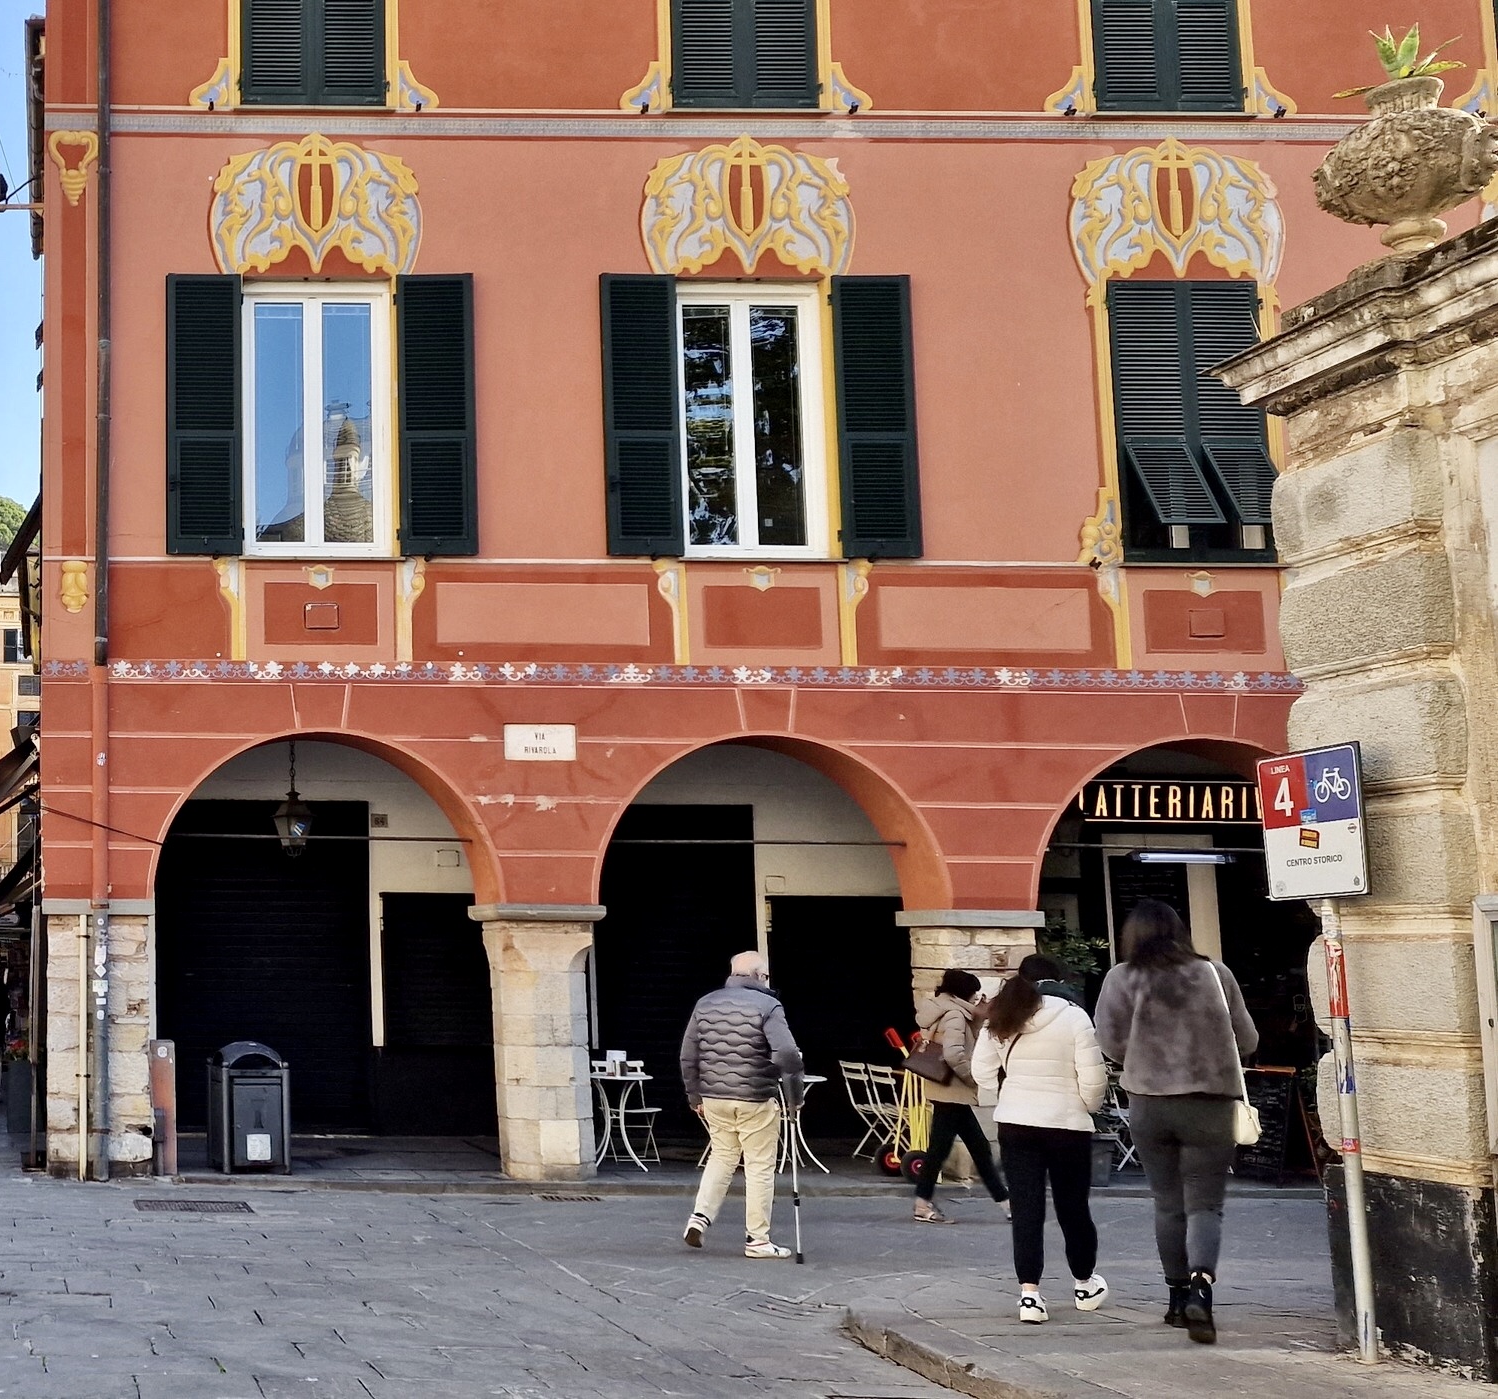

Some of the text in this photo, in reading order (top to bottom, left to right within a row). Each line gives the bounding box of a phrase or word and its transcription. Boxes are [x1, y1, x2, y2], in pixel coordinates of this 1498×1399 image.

[534, 732, 546, 741] VIA
[524, 746, 557, 755] RIVAROLA
[1270, 764, 1291, 775] LINEA
[1274, 777, 1294, 817] 4
[1286, 854, 1343, 868] CENTRO STORICO
